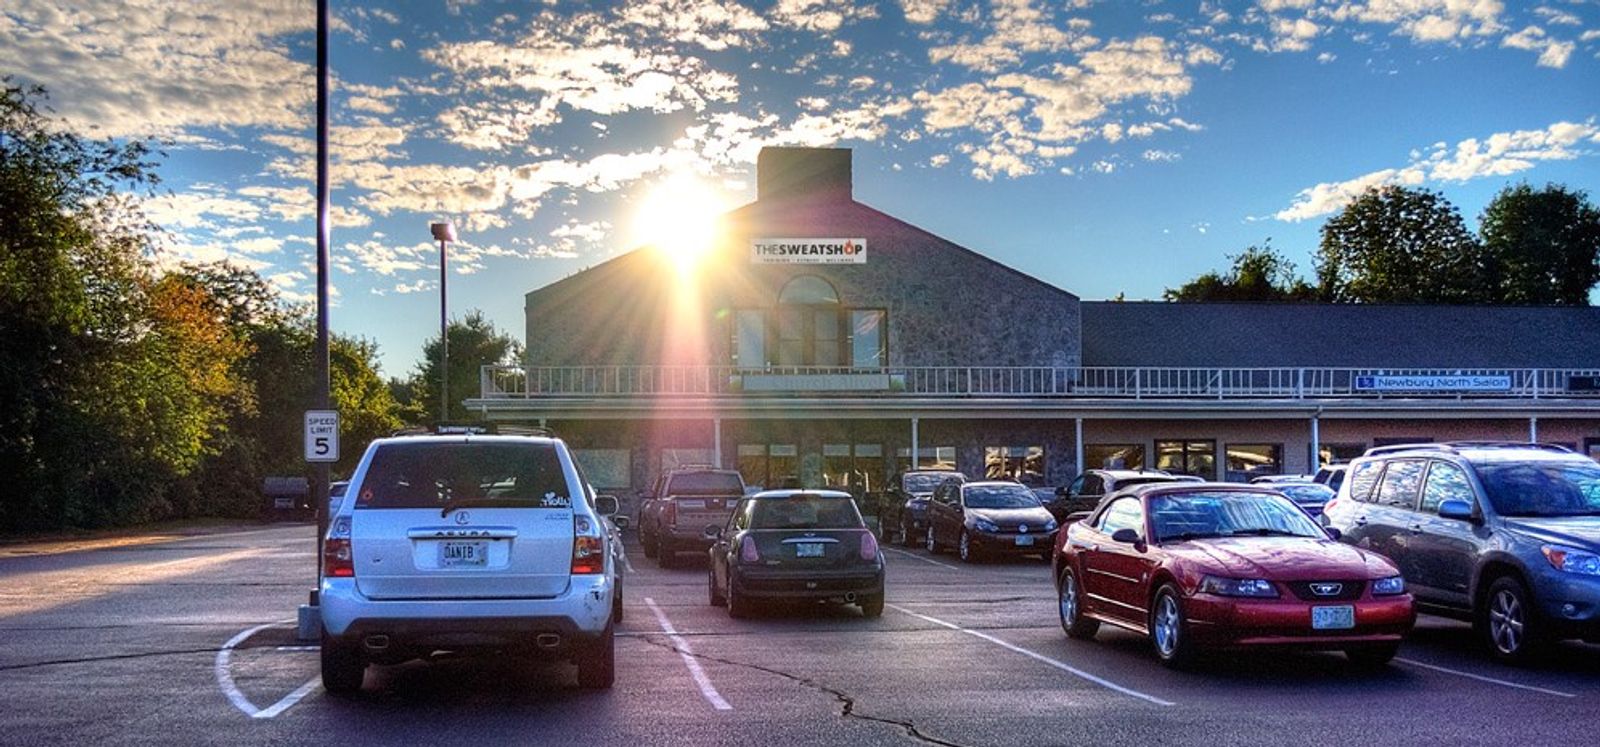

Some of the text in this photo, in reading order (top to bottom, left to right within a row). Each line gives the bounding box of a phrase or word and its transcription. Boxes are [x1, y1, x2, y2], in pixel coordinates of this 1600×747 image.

[1378, 378, 1508, 388] Newbury North Salon
[308, 417, 337, 425] SPEED
[315, 437, 329, 455] 5
